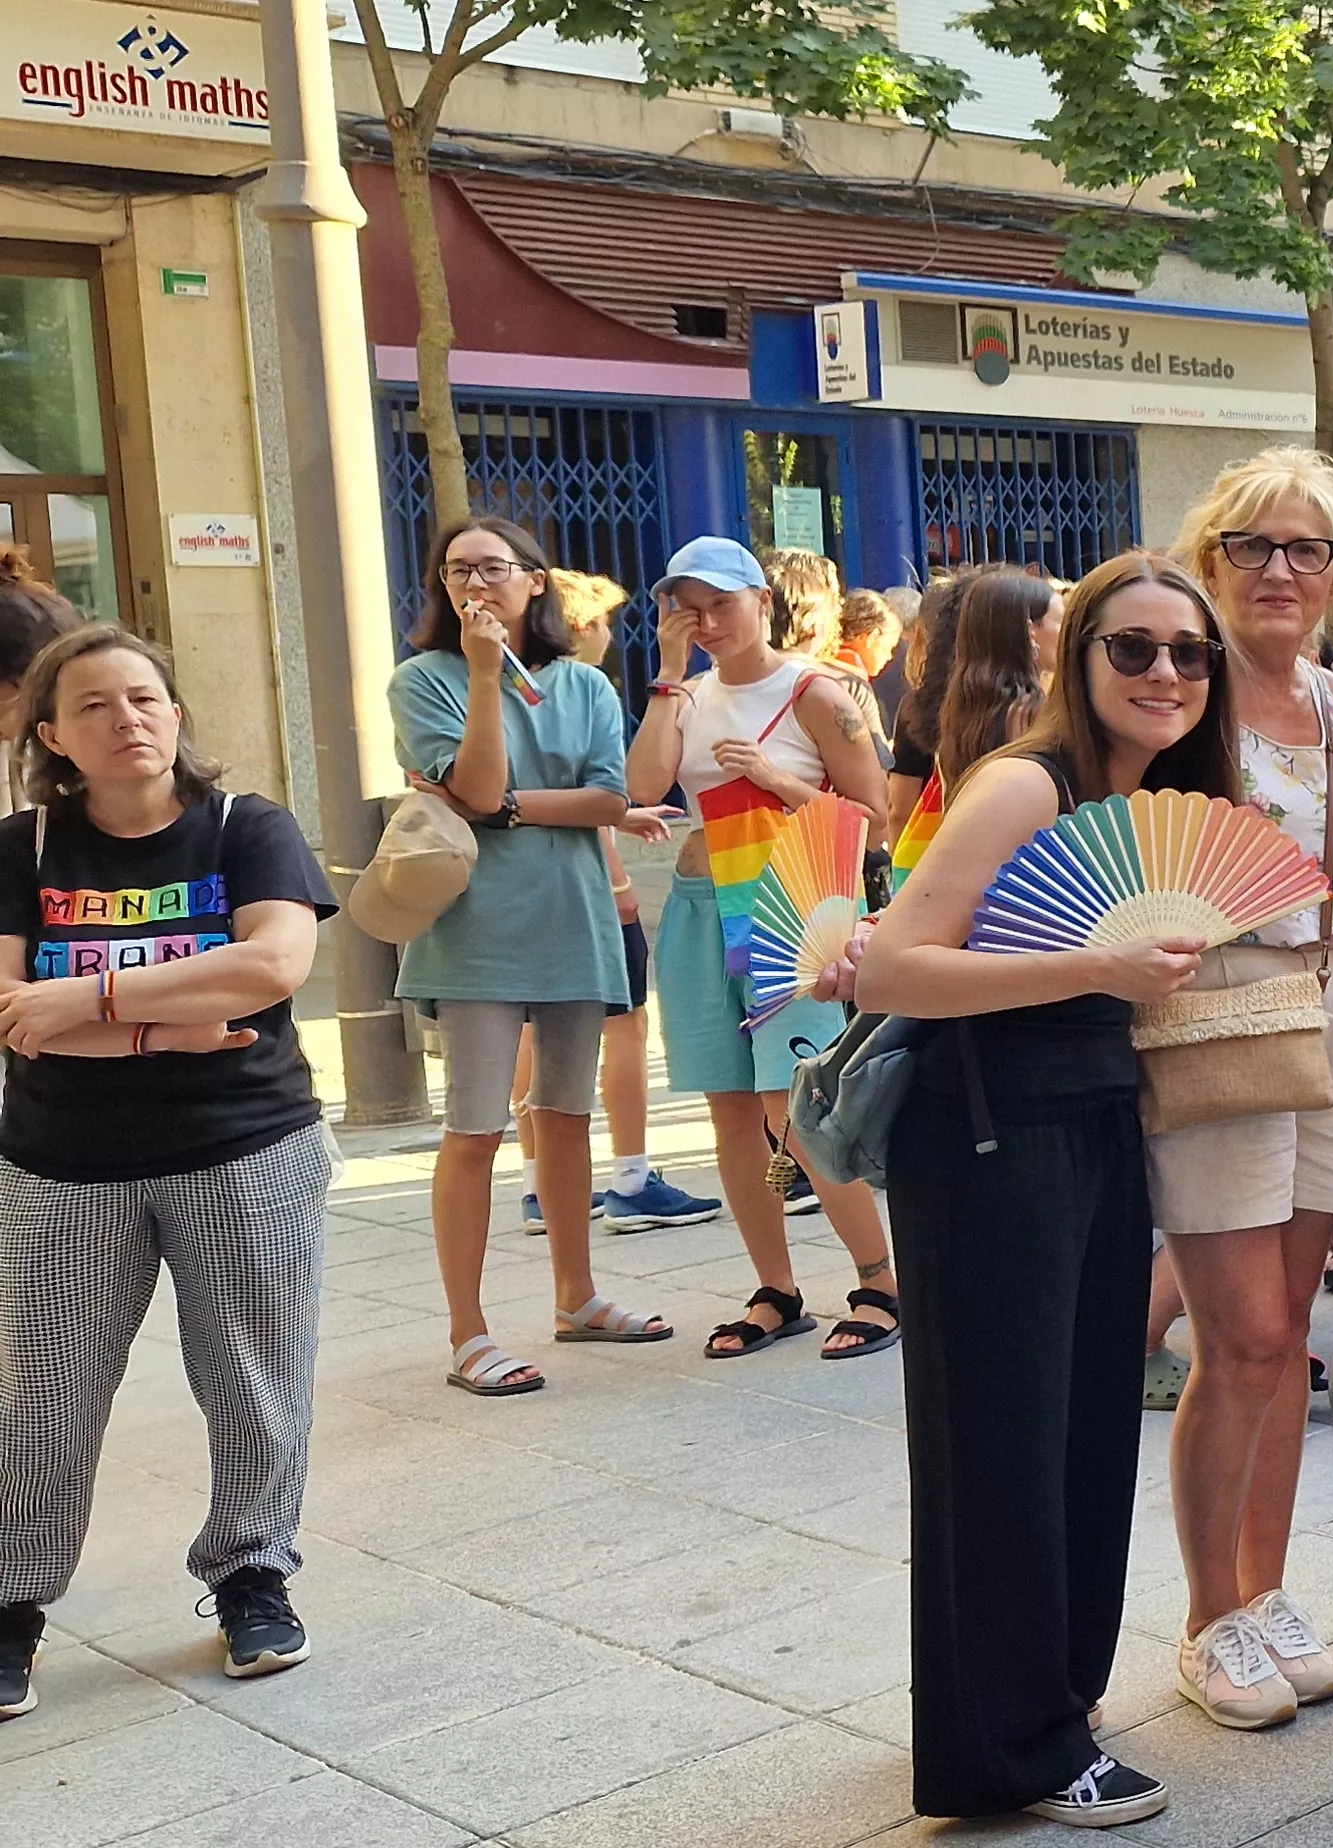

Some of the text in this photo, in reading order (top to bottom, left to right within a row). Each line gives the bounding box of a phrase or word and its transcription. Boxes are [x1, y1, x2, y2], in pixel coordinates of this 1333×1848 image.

[18, 60, 268, 119] english maths
[159, 111, 172, 122] DE
[1024, 313, 1130, 348] Loterías y
[1026, 344, 1235, 381] Apuestas del Estado
[1171, 406, 1206, 419] Huesca
[178, 534, 250, 552] english maths
